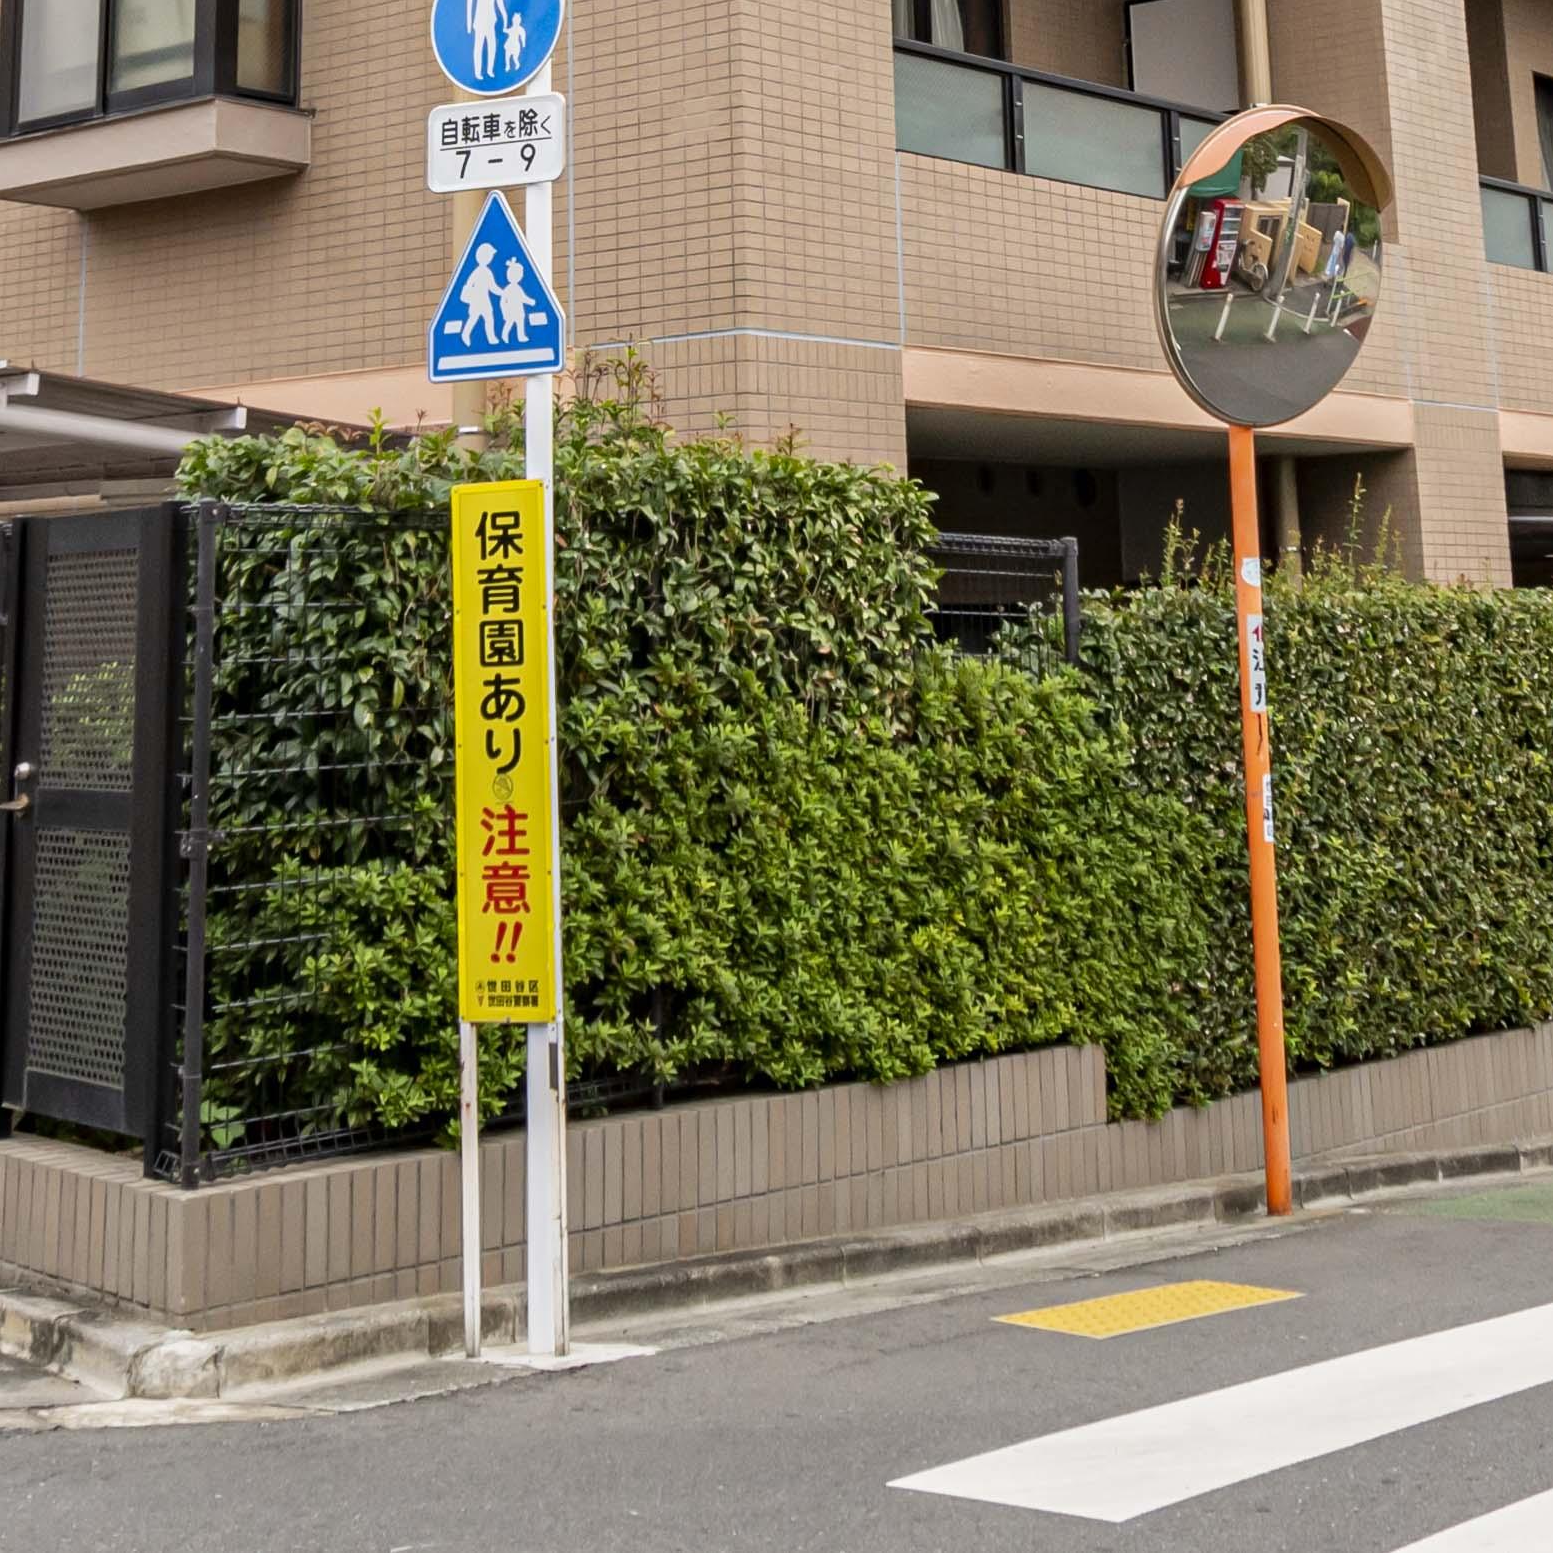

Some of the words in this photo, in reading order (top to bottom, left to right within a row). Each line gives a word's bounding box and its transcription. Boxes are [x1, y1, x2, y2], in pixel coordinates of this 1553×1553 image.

[441, 109, 551, 146] 自転車を除く
[475, 510, 526, 775] 保育園あり
